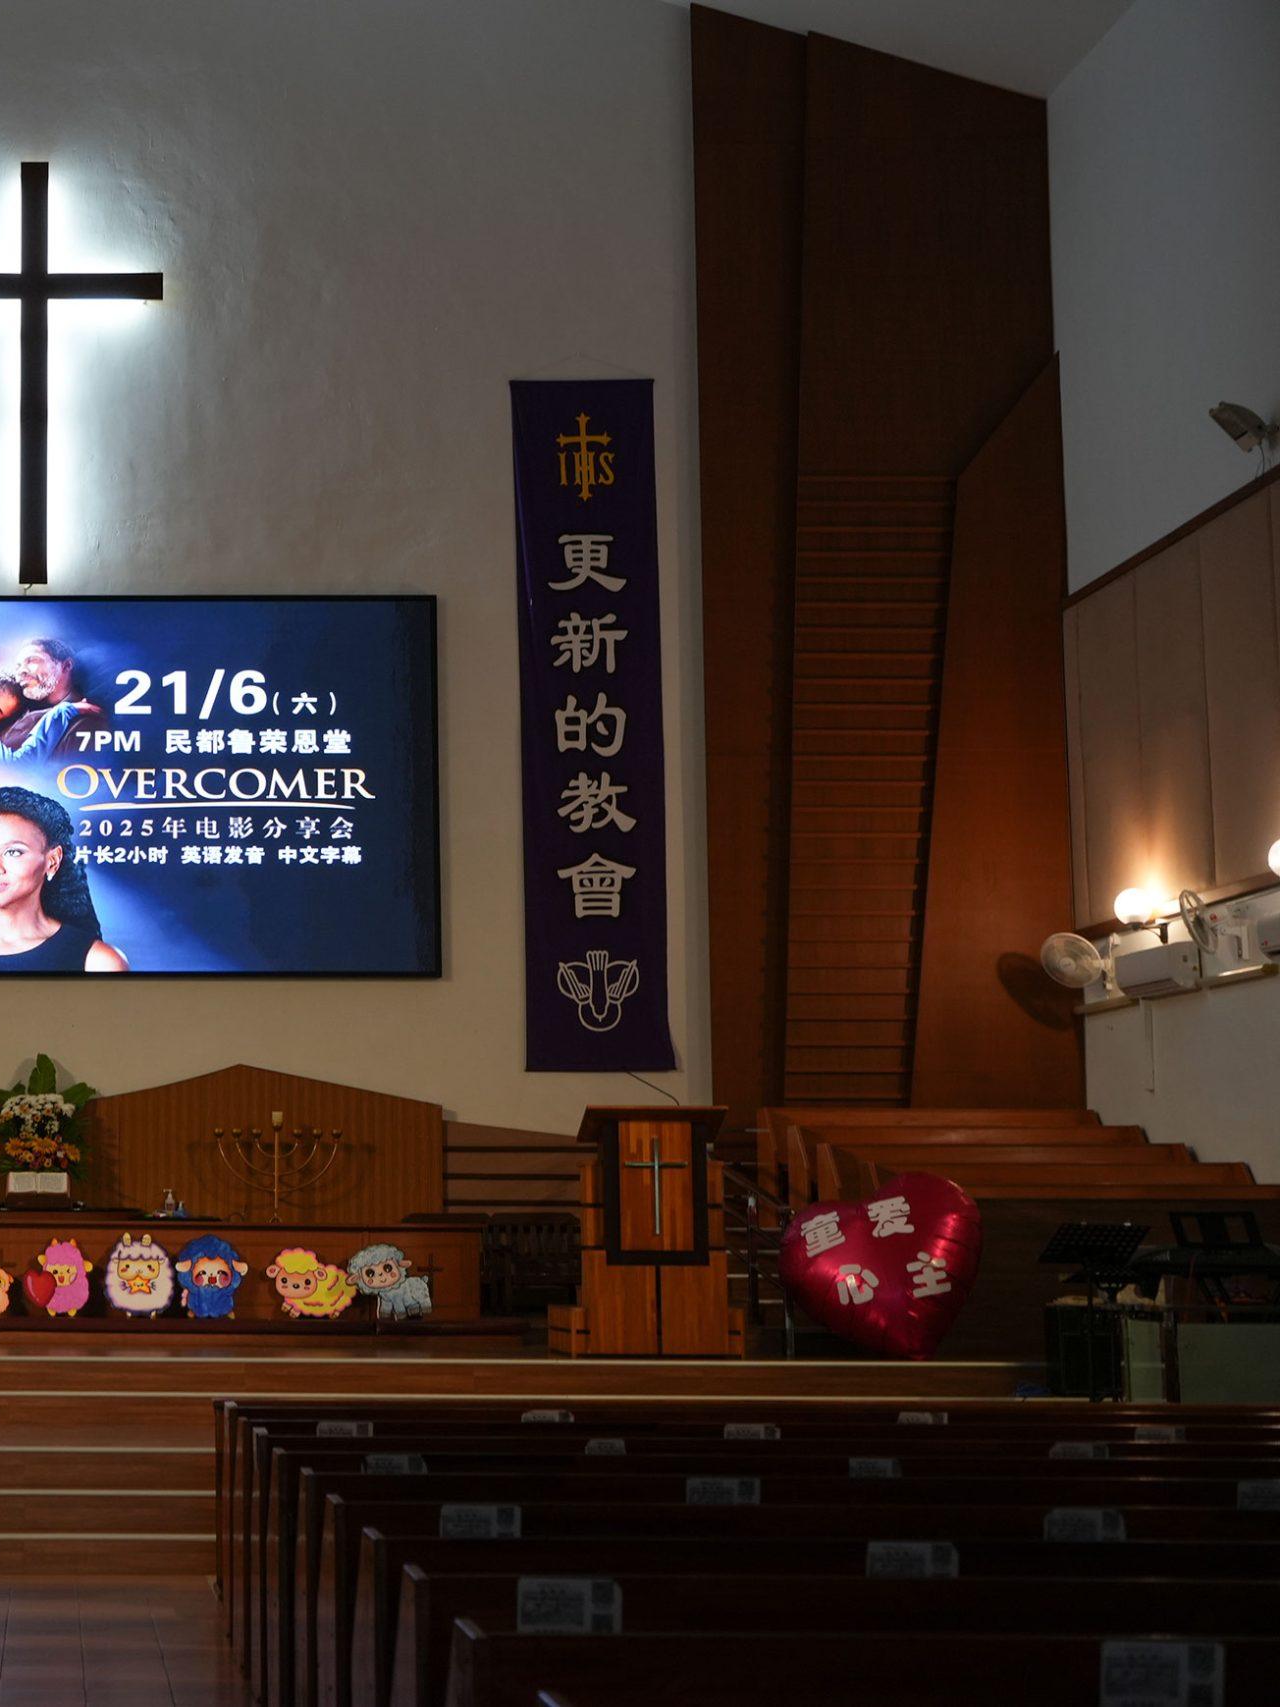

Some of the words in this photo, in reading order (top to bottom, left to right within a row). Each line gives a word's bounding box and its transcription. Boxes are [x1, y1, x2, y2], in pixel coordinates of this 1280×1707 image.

[556, 451, 616, 486] IHS
[75, 730, 141, 752] 7PM
[165, 728, 352, 755] 民都鲁荣恩堂
[548, 533, 637, 919] 更新的教會
[56, 763, 376, 800] OVERCOMER
[78, 816, 355, 839] 2025年电影分享会
[73, 845, 169, 865] 片长2小时
[180, 845, 266, 865] 英语发音
[277, 845, 362, 865] 中文字幕
